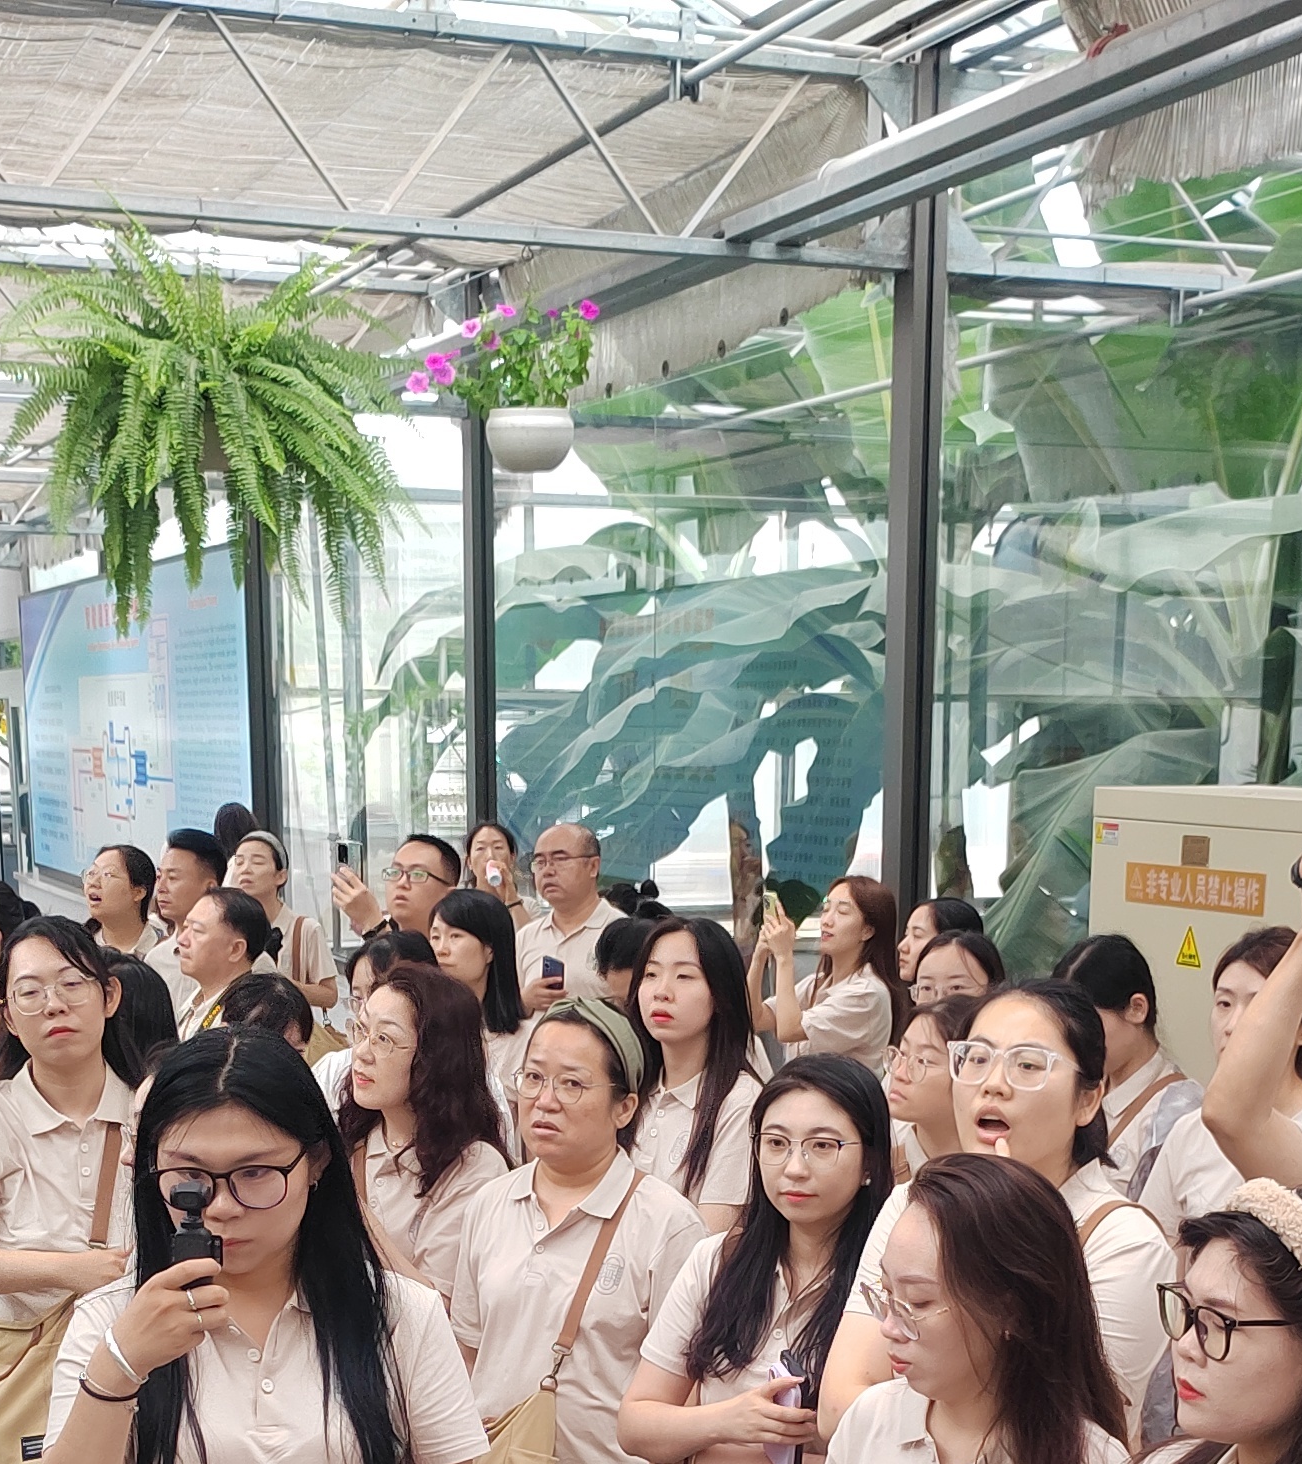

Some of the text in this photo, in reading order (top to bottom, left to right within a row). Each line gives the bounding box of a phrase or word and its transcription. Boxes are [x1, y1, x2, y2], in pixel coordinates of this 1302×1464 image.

[1145, 868, 1261, 911] 非专业人员禁止操作
